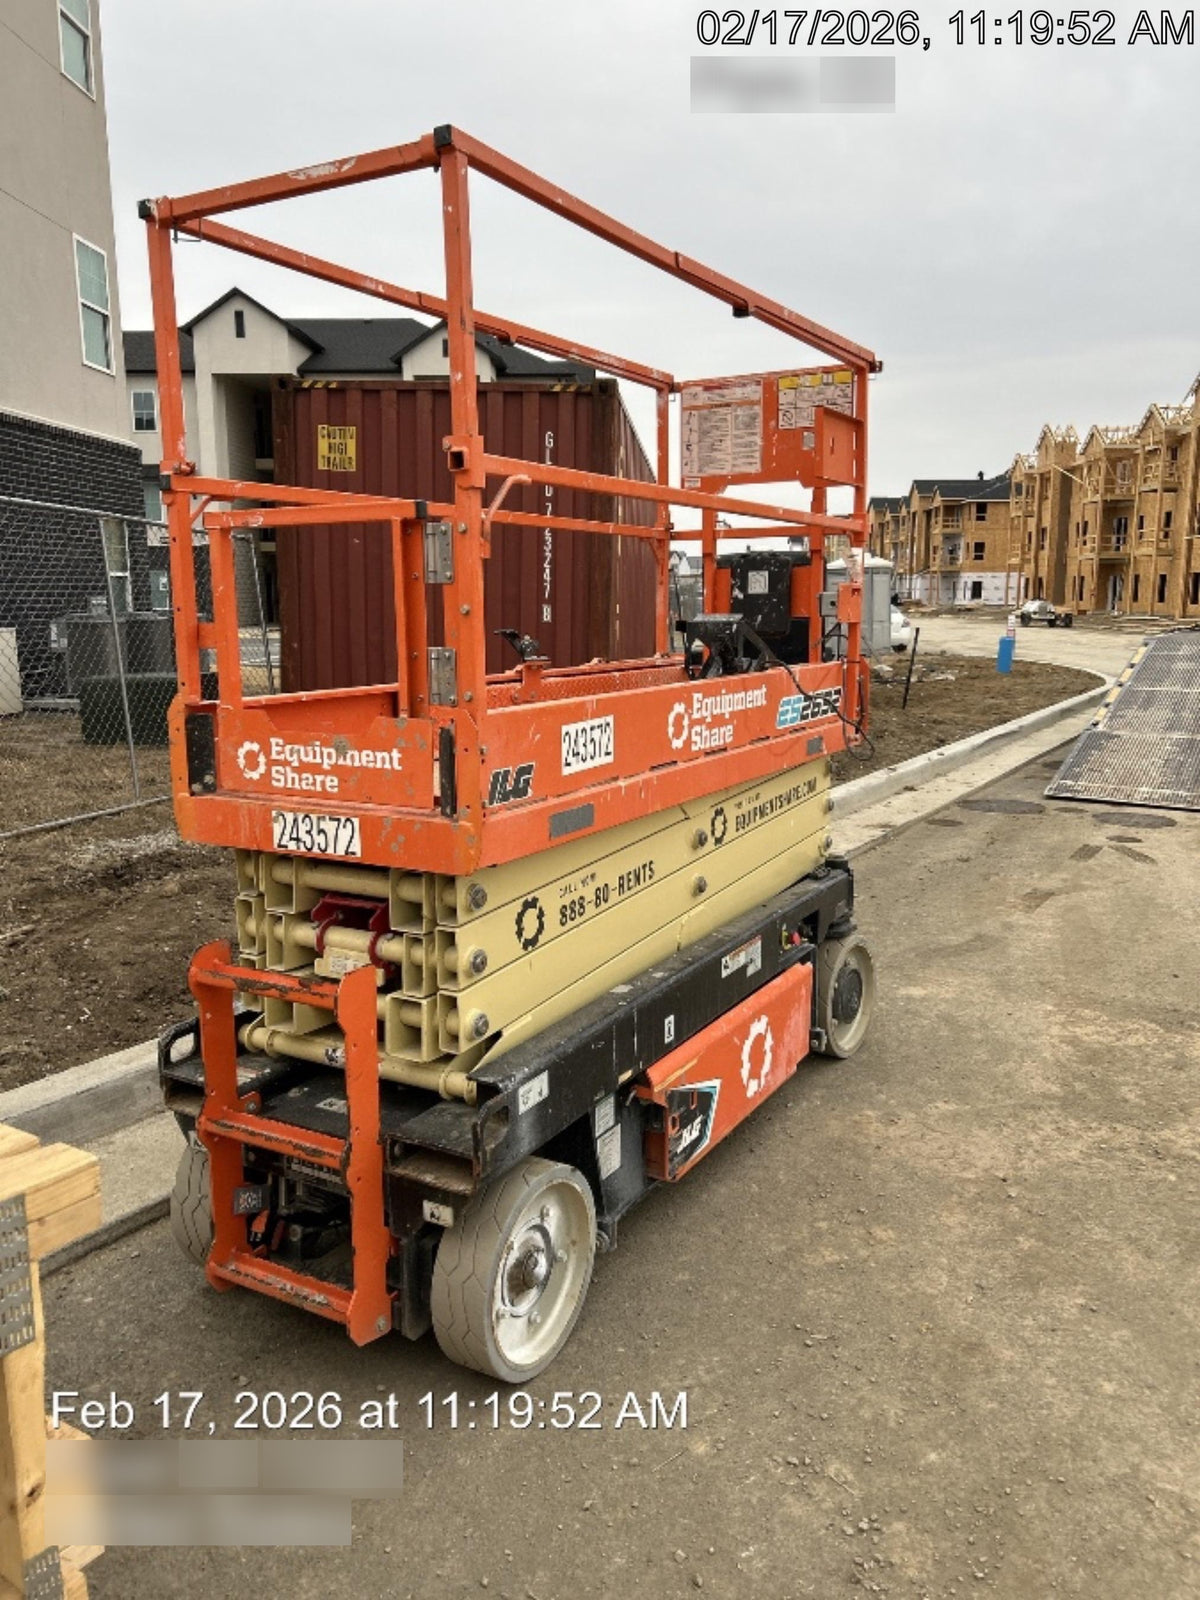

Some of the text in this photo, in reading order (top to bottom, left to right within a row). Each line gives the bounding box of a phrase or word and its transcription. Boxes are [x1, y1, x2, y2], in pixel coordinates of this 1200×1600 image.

[545, 431, 554, 497] GLU
[691, 684, 768, 722] Equipment
[270, 737, 403, 771] Equipment
[563, 721, 612, 767] 243572
[691, 724, 734, 751] Share
[271, 765, 339, 793] Share
[276, 811, 357, 856] 243572
[559, 860, 655, 926] 888-80-RENTS
